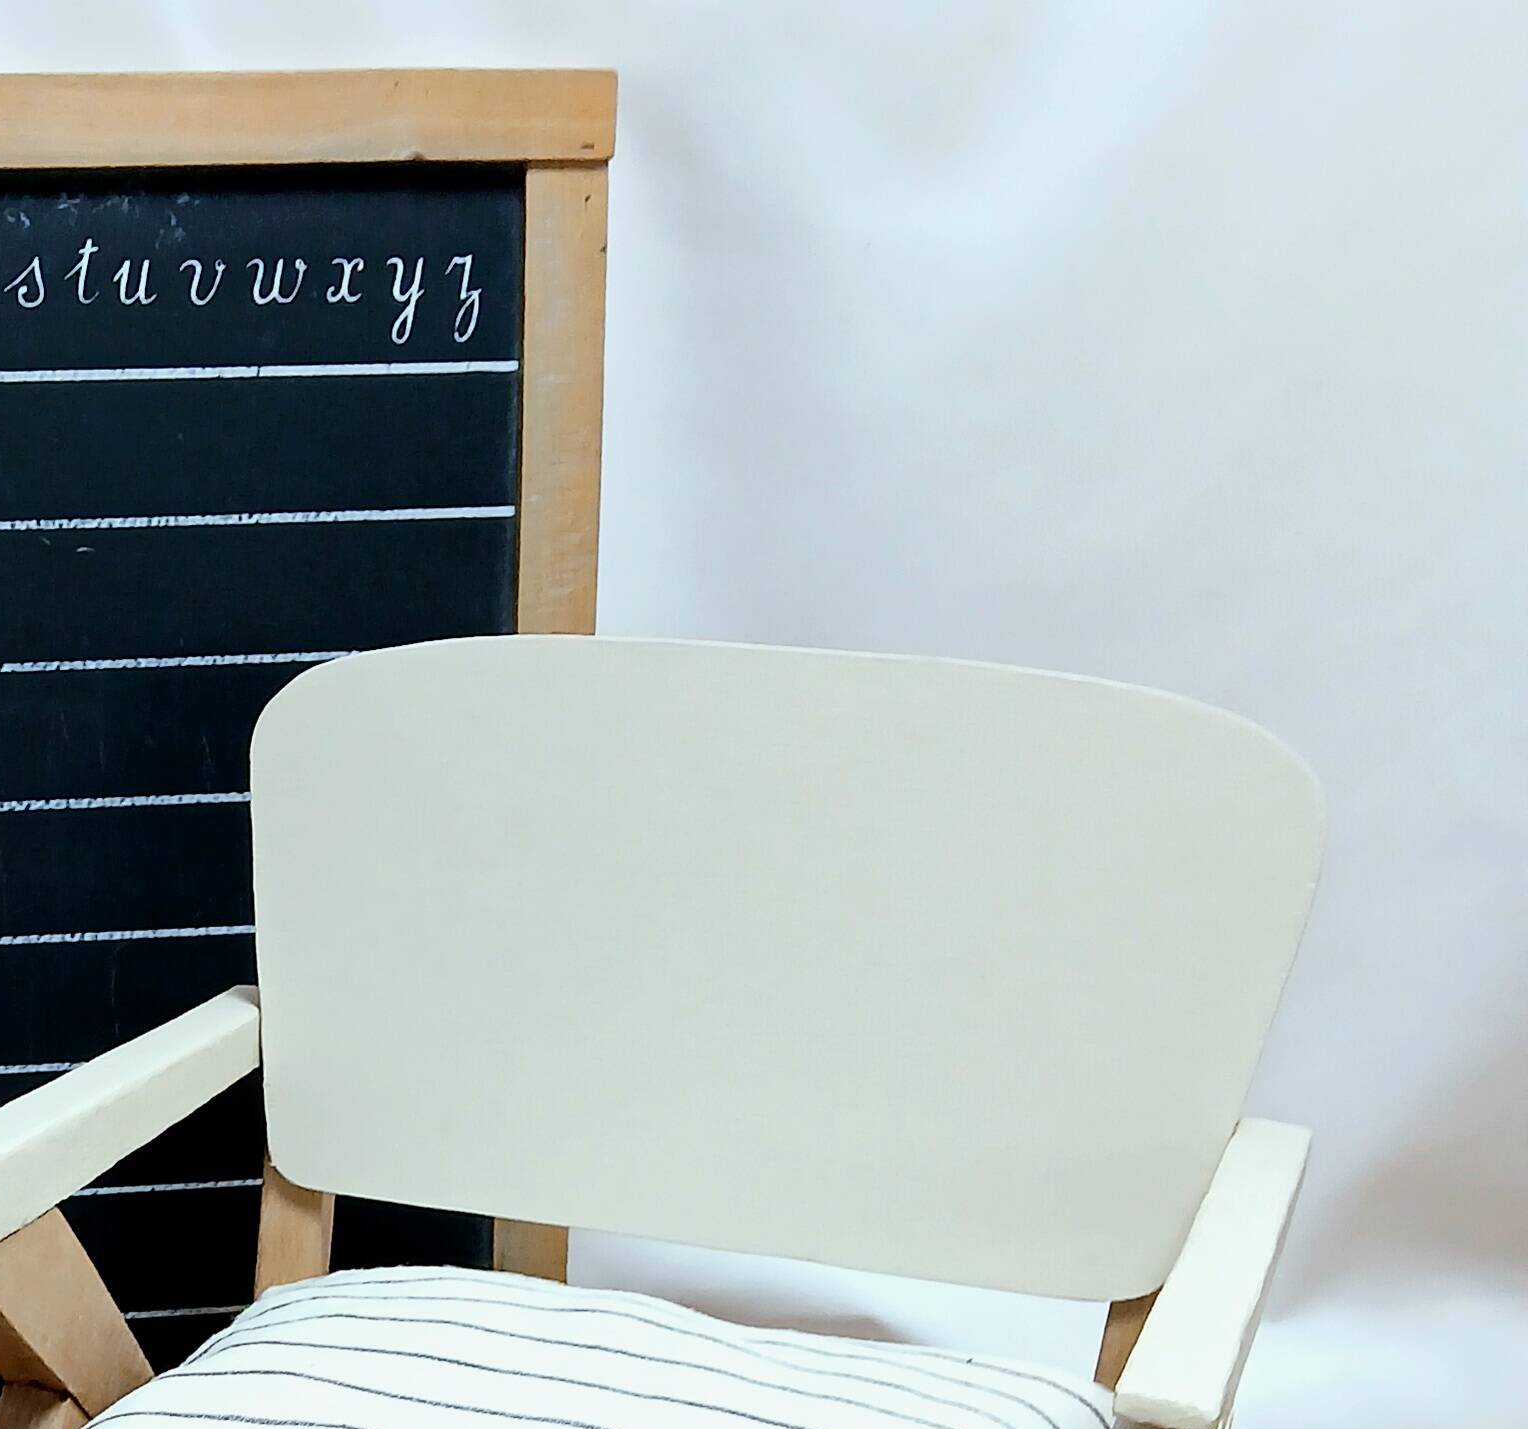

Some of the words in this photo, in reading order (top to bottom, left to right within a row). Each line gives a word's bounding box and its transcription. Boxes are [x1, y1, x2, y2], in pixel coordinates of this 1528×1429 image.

[3, 252, 46, 308] s
[63, 238, 100, 305] t
[112, 255, 158, 305] u
[178, 259, 226, 306] v
[246, 258, 308, 305] w
[326, 256, 364, 304] x
[386, 256, 425, 345] y
[444, 254, 483, 343] z
